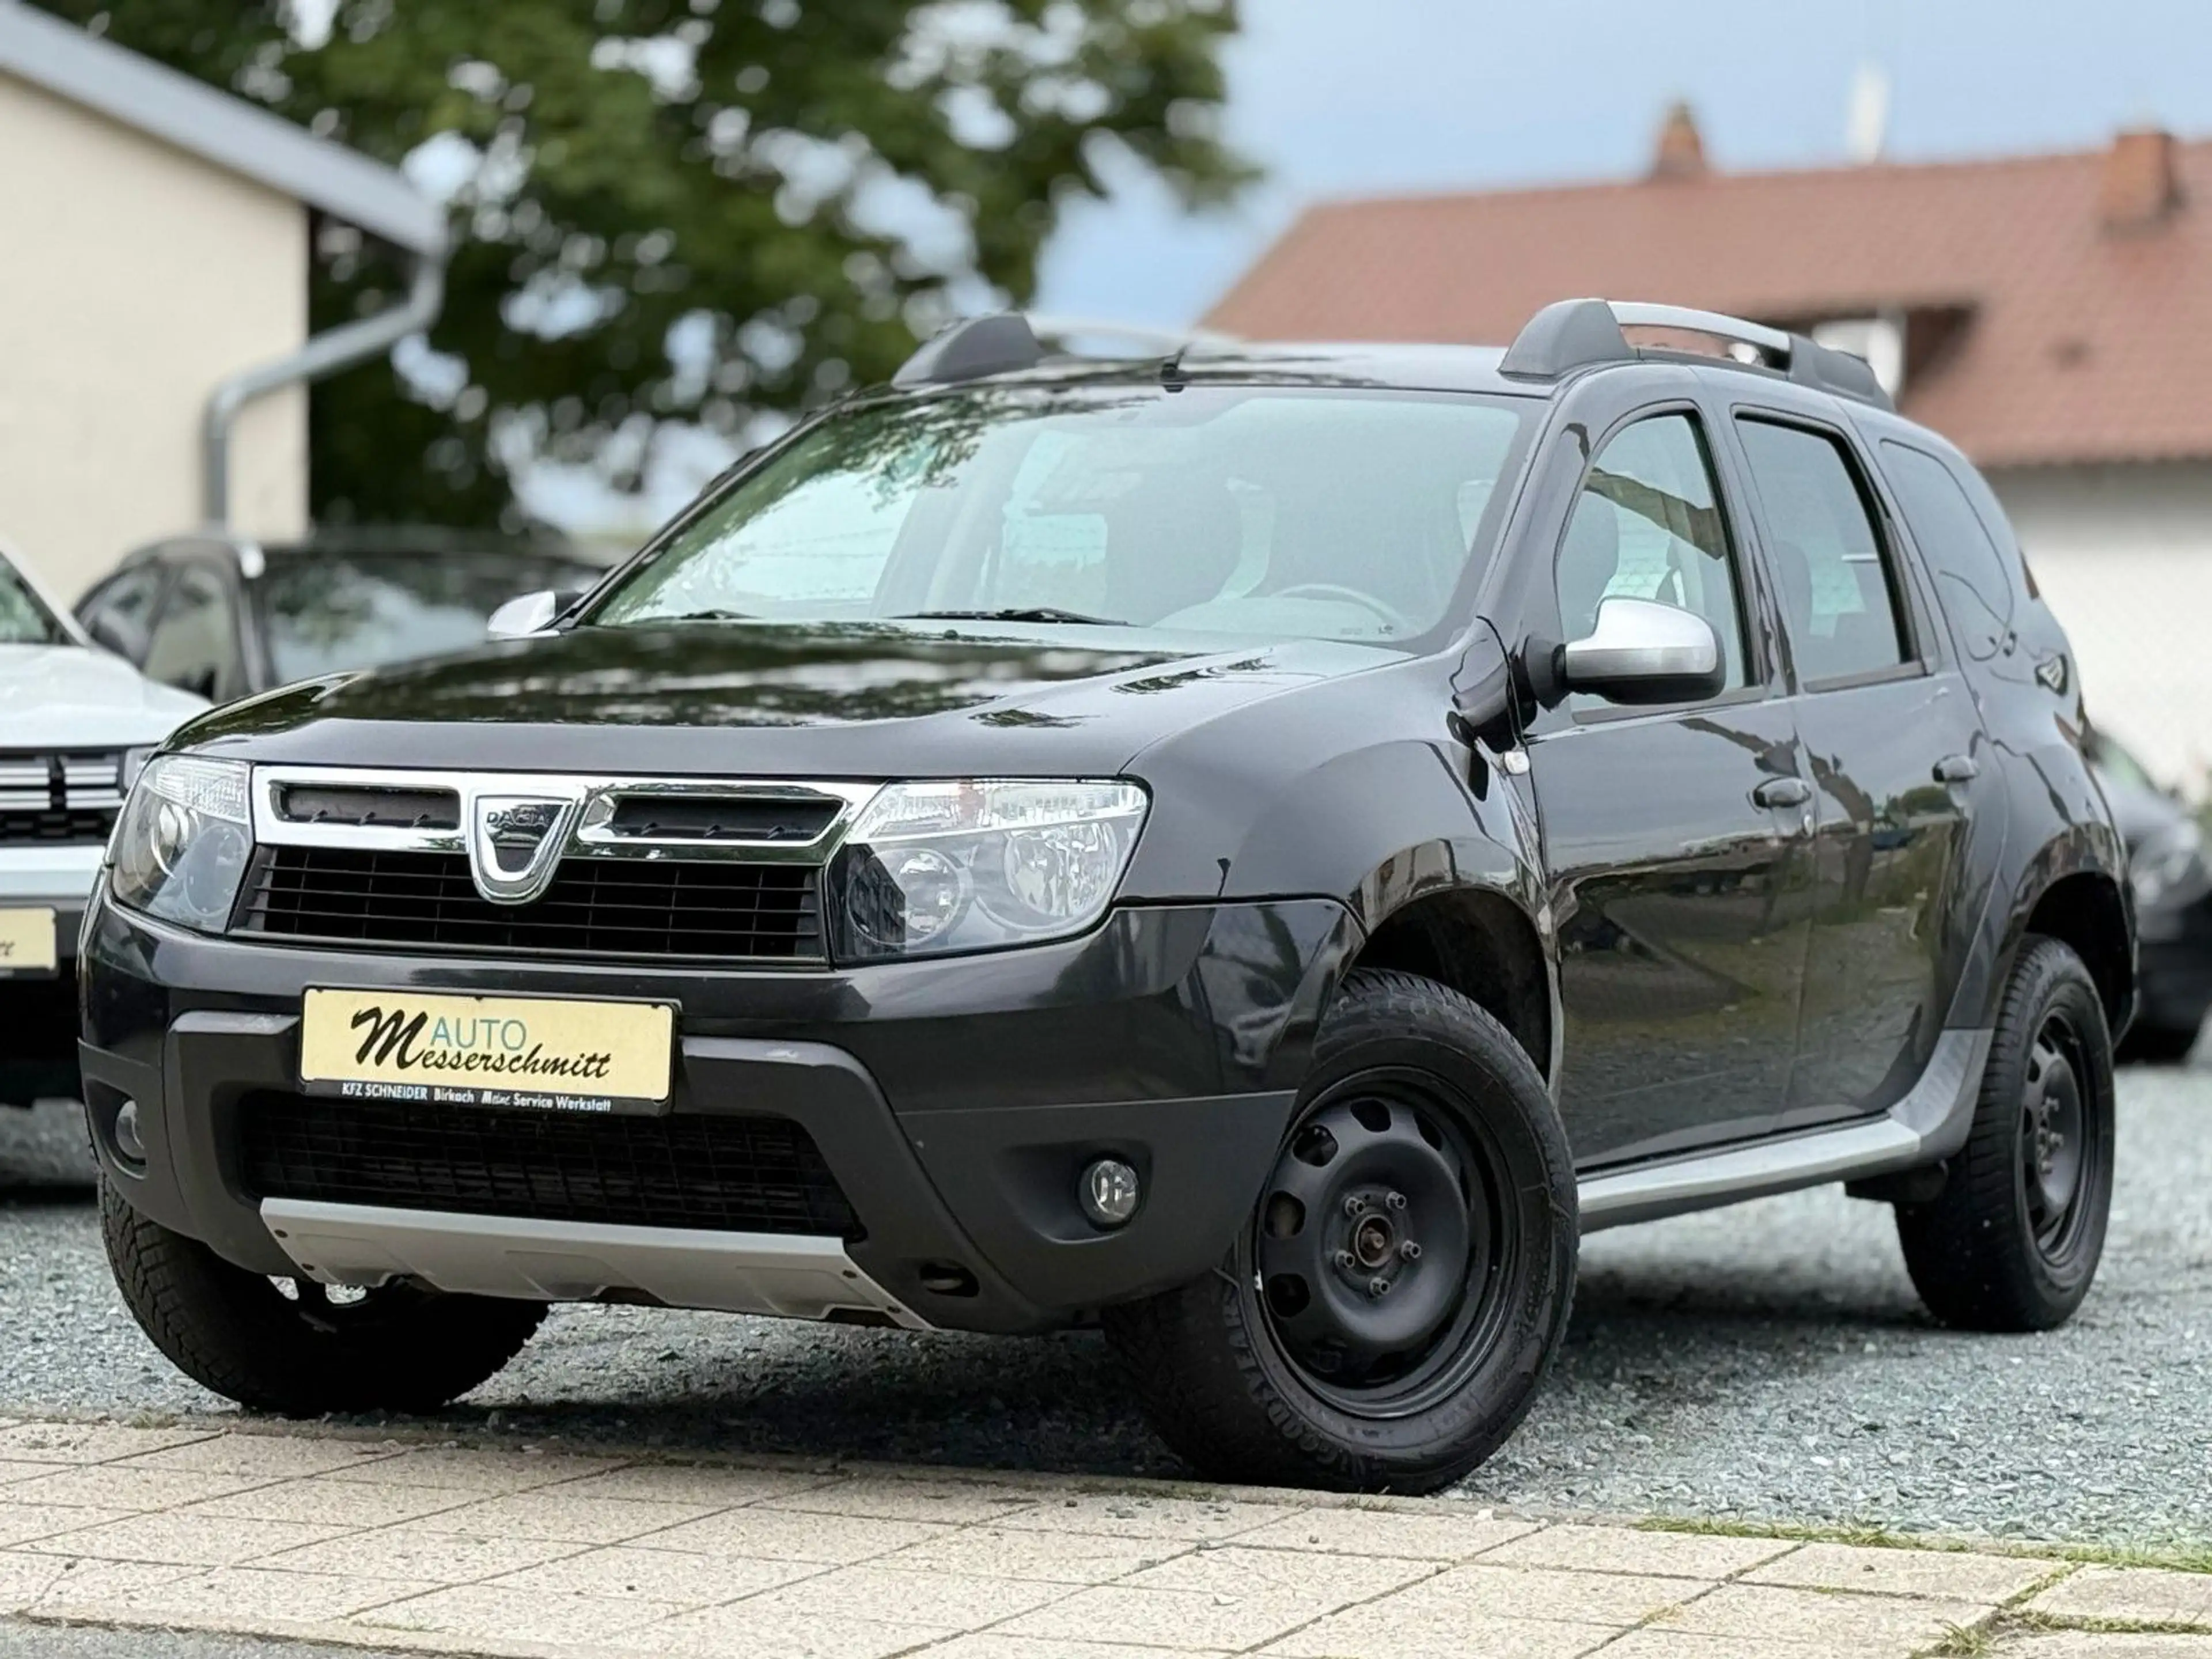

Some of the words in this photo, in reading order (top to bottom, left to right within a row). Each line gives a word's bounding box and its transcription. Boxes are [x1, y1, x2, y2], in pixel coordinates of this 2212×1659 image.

[487, 810, 548, 828] DACIA
[351, 1006, 611, 1078] Messerschmitt
[430, 1017, 527, 1051] AUTO
[342, 1082, 363, 1096] KFZ
[365, 1084, 427, 1100] SCHNEIDER
[434, 1088, 474, 1103] Birkach
[513, 1093, 553, 1108] Service
[556, 1096, 611, 1112] Werkstatt
